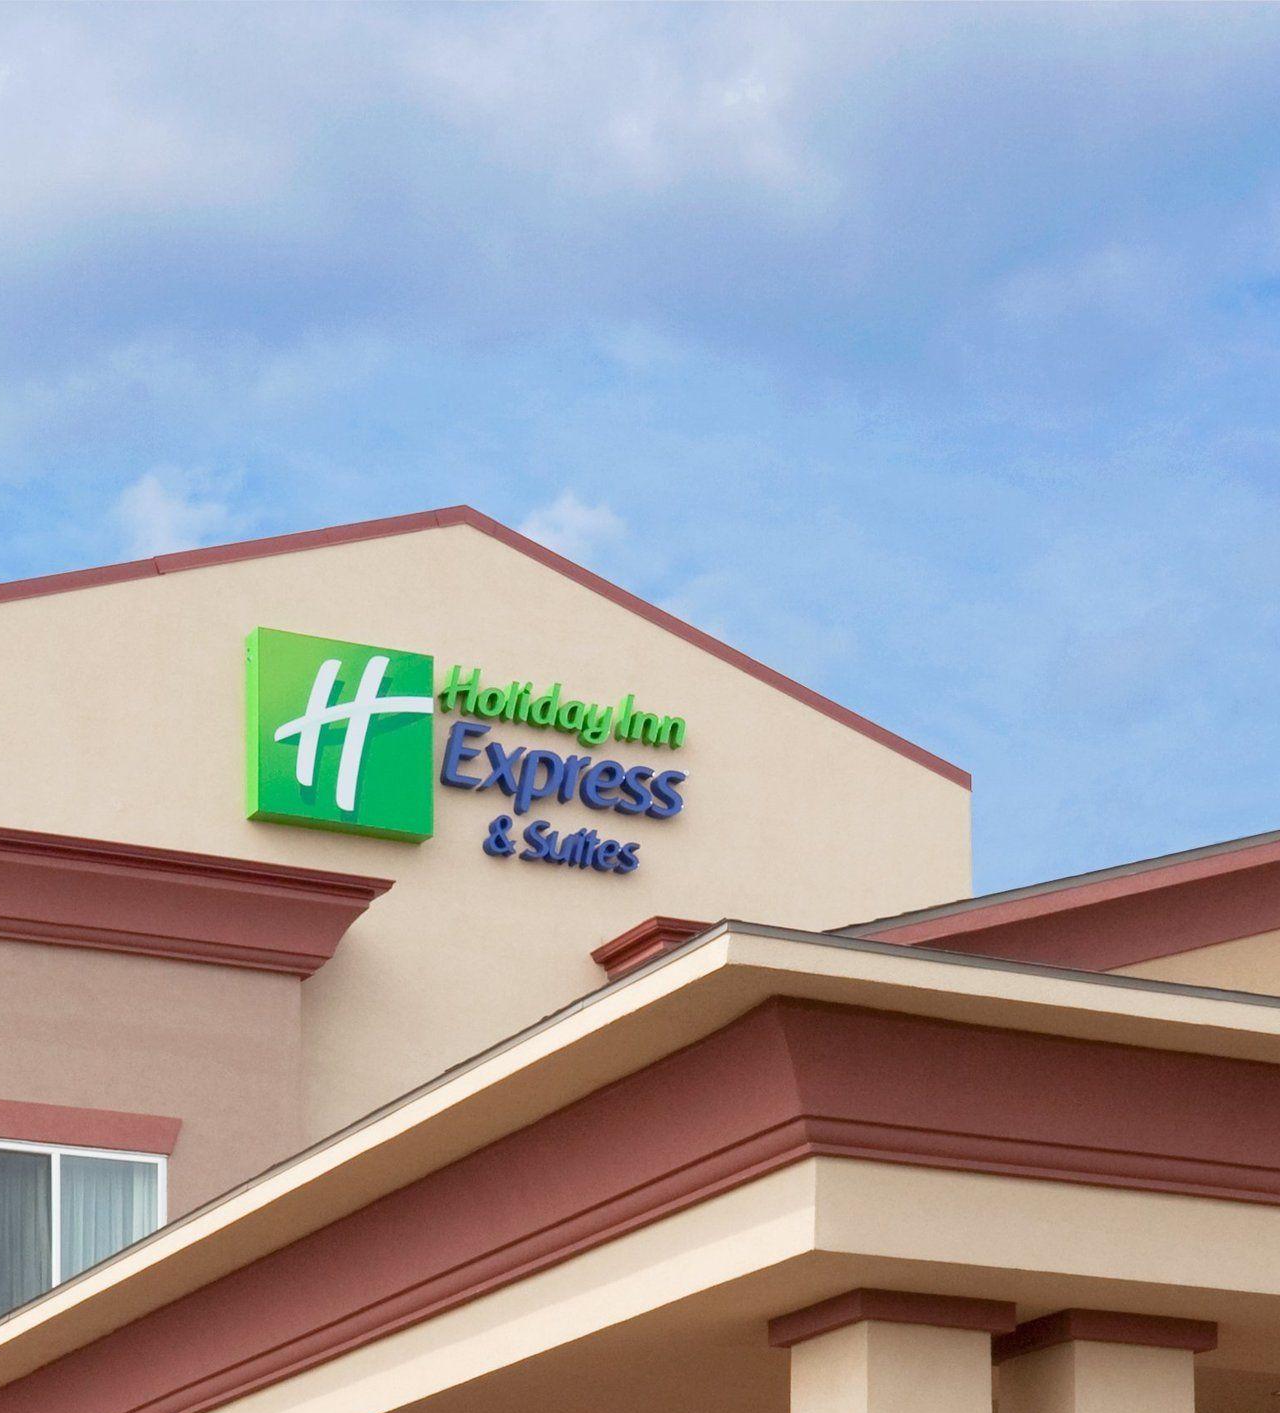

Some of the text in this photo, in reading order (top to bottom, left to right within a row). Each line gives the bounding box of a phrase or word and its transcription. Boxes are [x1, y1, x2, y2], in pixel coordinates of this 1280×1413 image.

[437, 664, 687, 749] Holiday Inn
[440, 720, 687, 819] Express
[482, 814, 641, 875] & Suites
